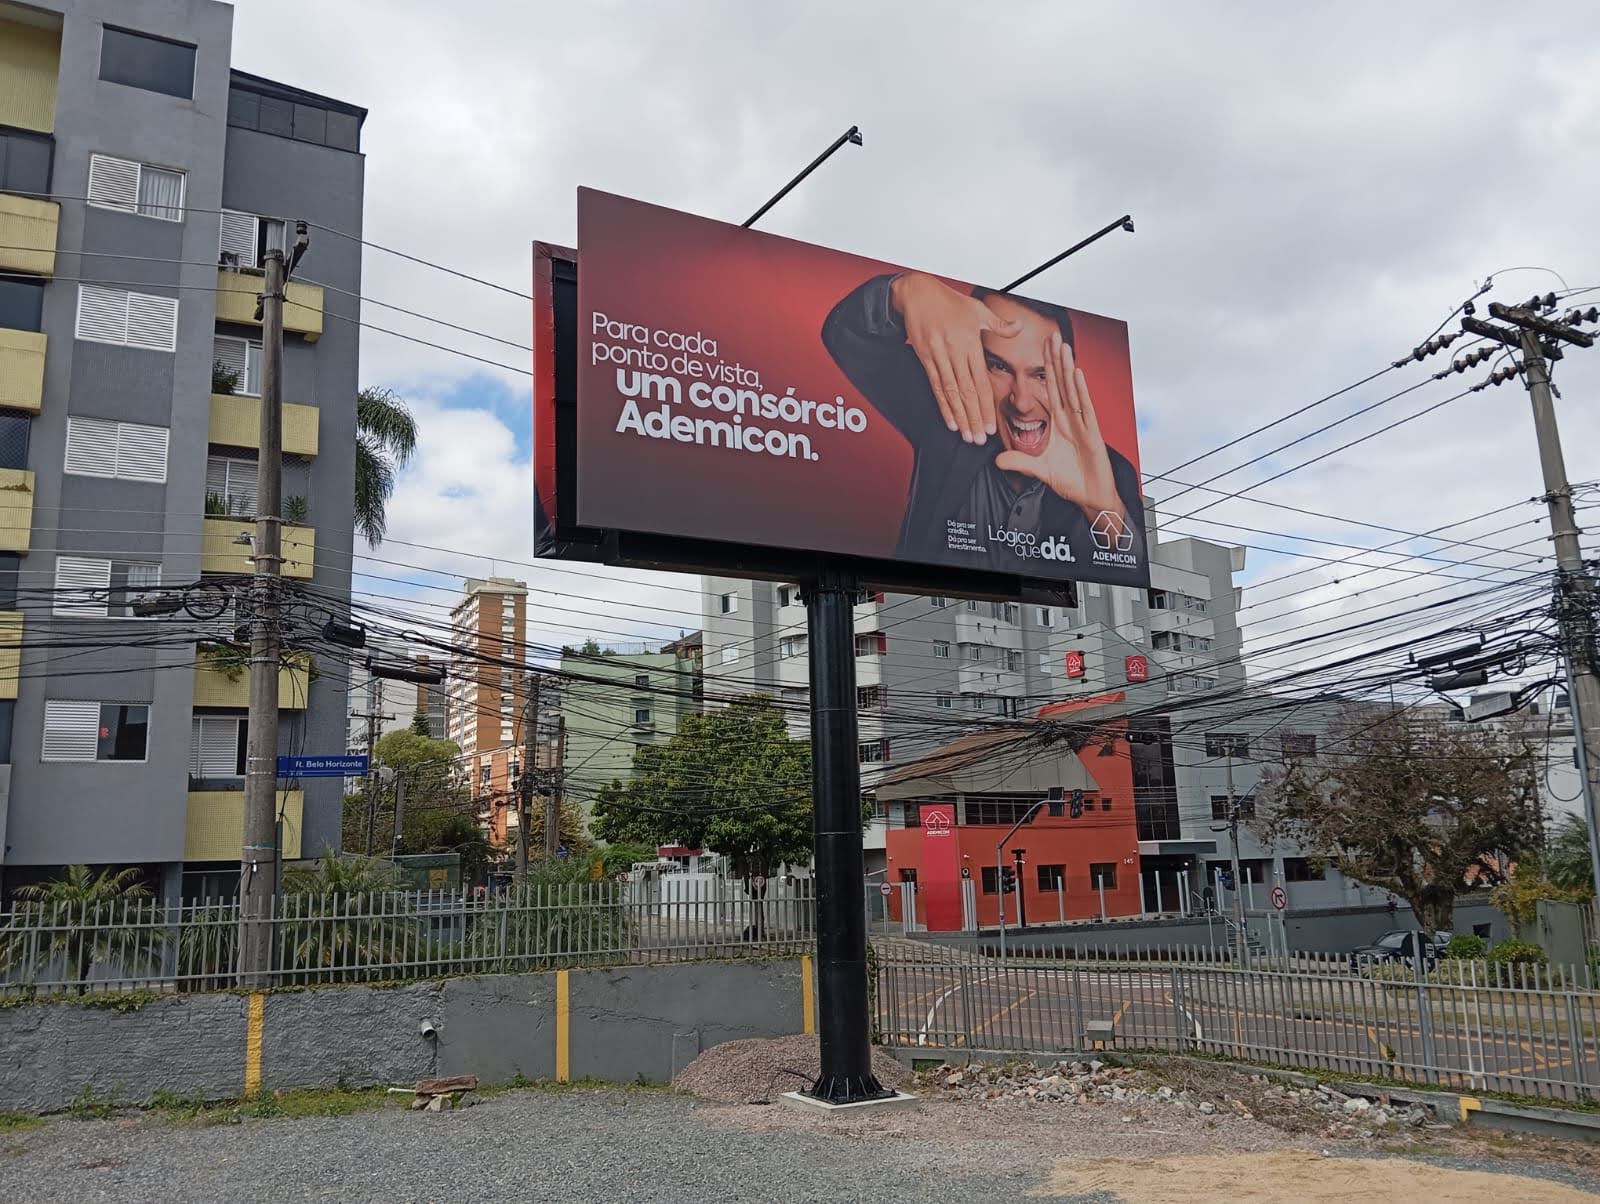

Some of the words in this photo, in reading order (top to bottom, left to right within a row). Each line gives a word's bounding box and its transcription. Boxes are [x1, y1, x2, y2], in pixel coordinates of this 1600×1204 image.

[592, 312, 648, 344] Para
[654, 331, 717, 357] cada
[592, 341, 668, 371] ponto
[671, 353, 703, 377] de
[707, 360, 763, 391] vista,
[616, 368, 682, 404] um
[689, 387, 867, 433] consórcio
[616, 400, 819, 461] Ademicon.
[988, 525, 1036, 547] Lógico
[1015, 545, 1041, 560] que
[1040, 535, 1076, 563] dá.
[1092, 550, 1136, 564] ADEMICON
[306, 760, 325, 768] Belo
[326, 760, 363, 768] Horizonte
